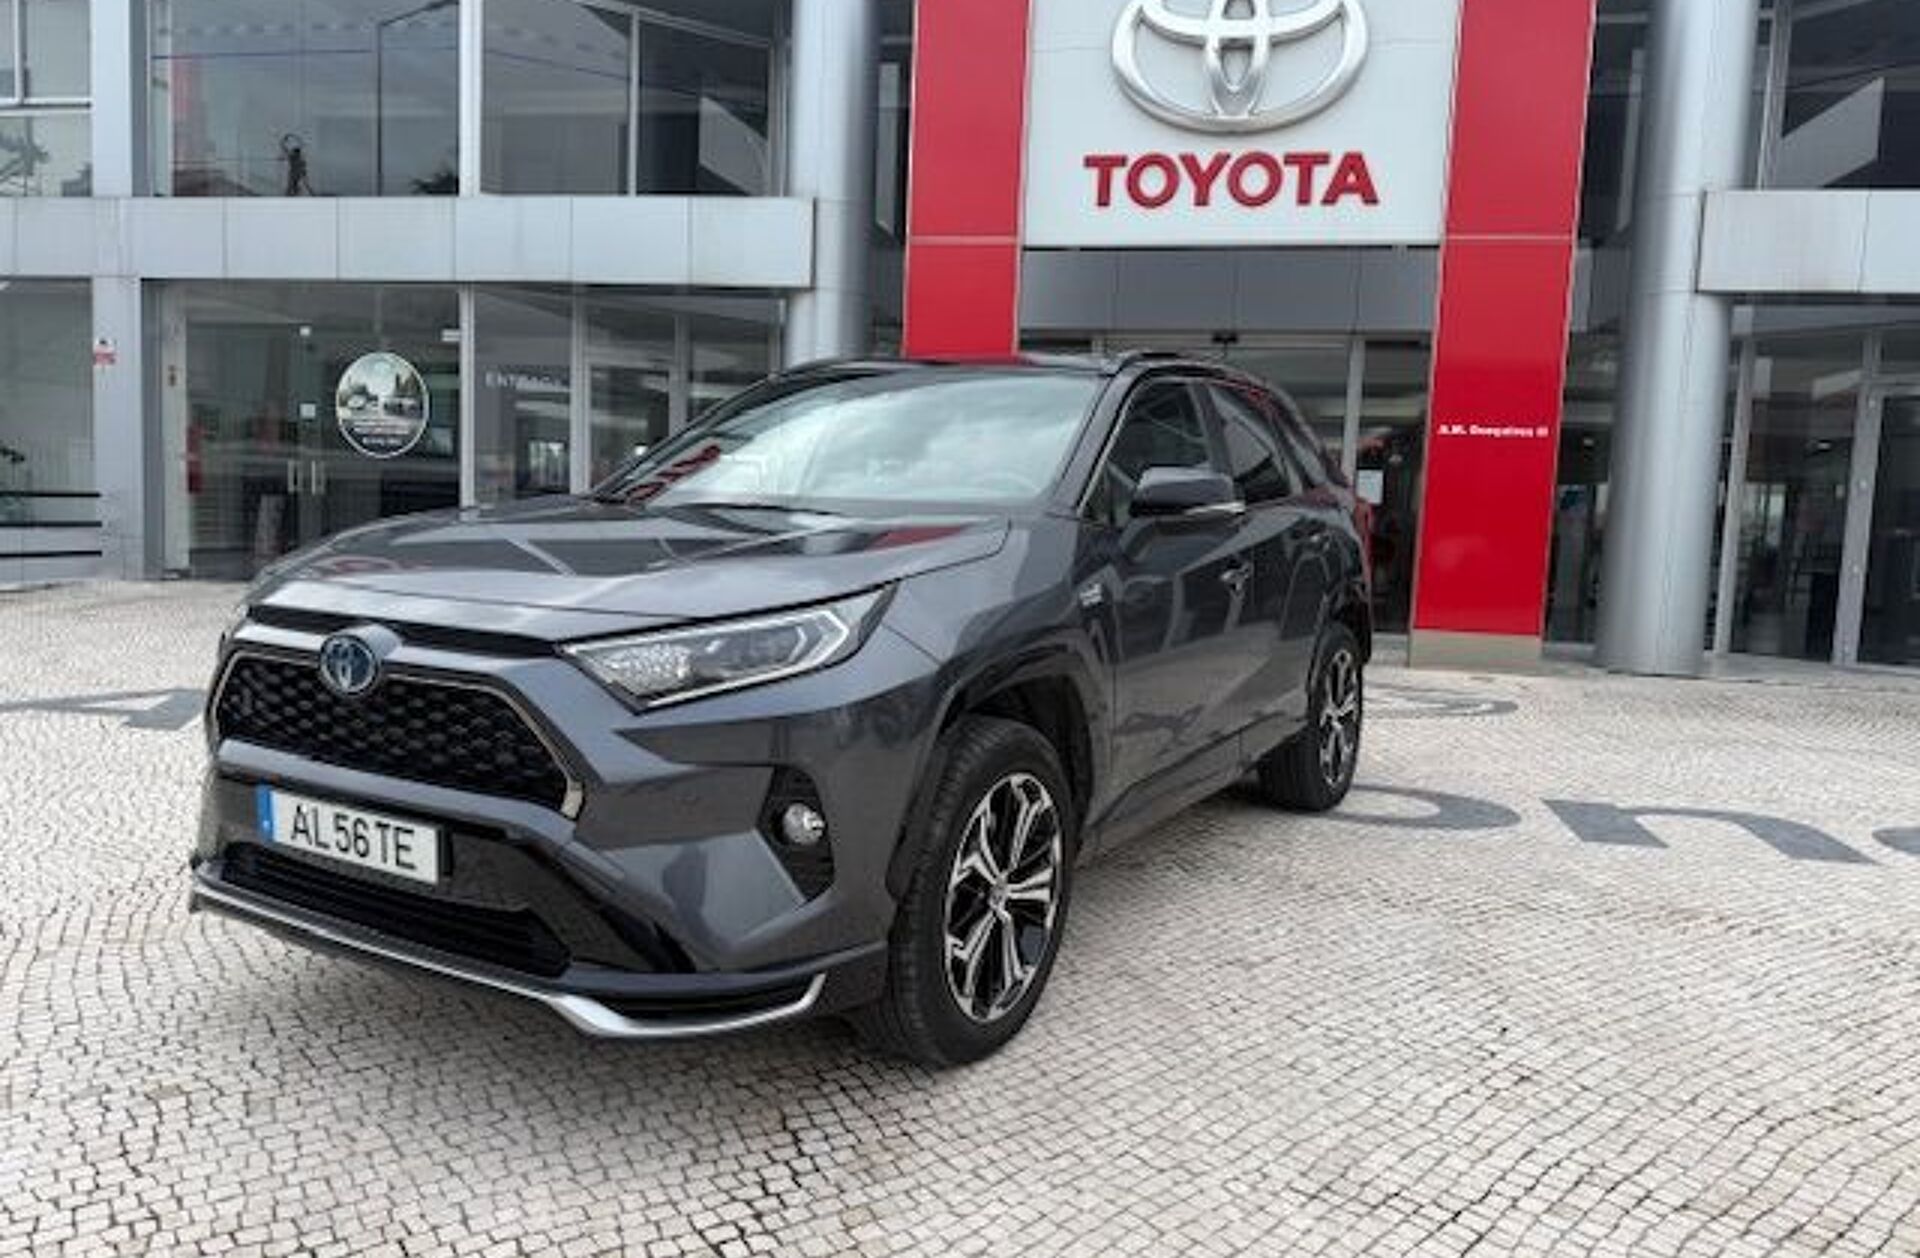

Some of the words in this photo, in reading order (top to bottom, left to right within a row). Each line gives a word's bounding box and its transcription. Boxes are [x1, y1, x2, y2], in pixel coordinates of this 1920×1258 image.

[1084, 151, 1379, 208] TOYOTA
[291, 805, 331, 849] AL
[333, 812, 370, 858] 56
[375, 820, 417, 870] TE
